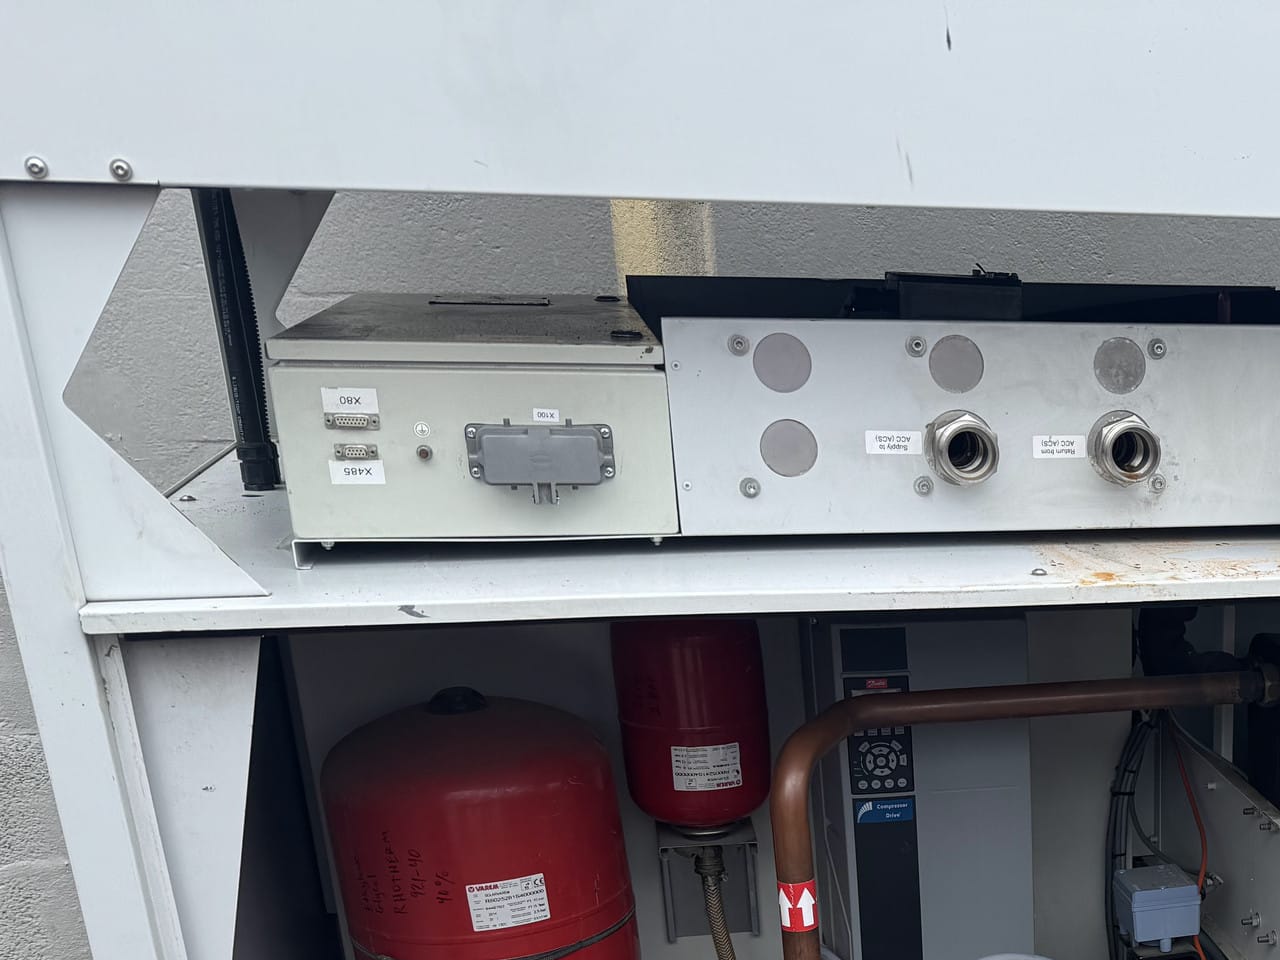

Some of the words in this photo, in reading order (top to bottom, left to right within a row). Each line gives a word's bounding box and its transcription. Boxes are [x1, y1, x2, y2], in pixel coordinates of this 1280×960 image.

[339, 395, 361, 406] X80
[537, 411, 555, 419] X100
[875, 435, 895, 443] (ACS)
[887, 444, 908, 452] Supply
[343, 467, 373, 477] X485
[876, 802, 908, 811] Compressor
